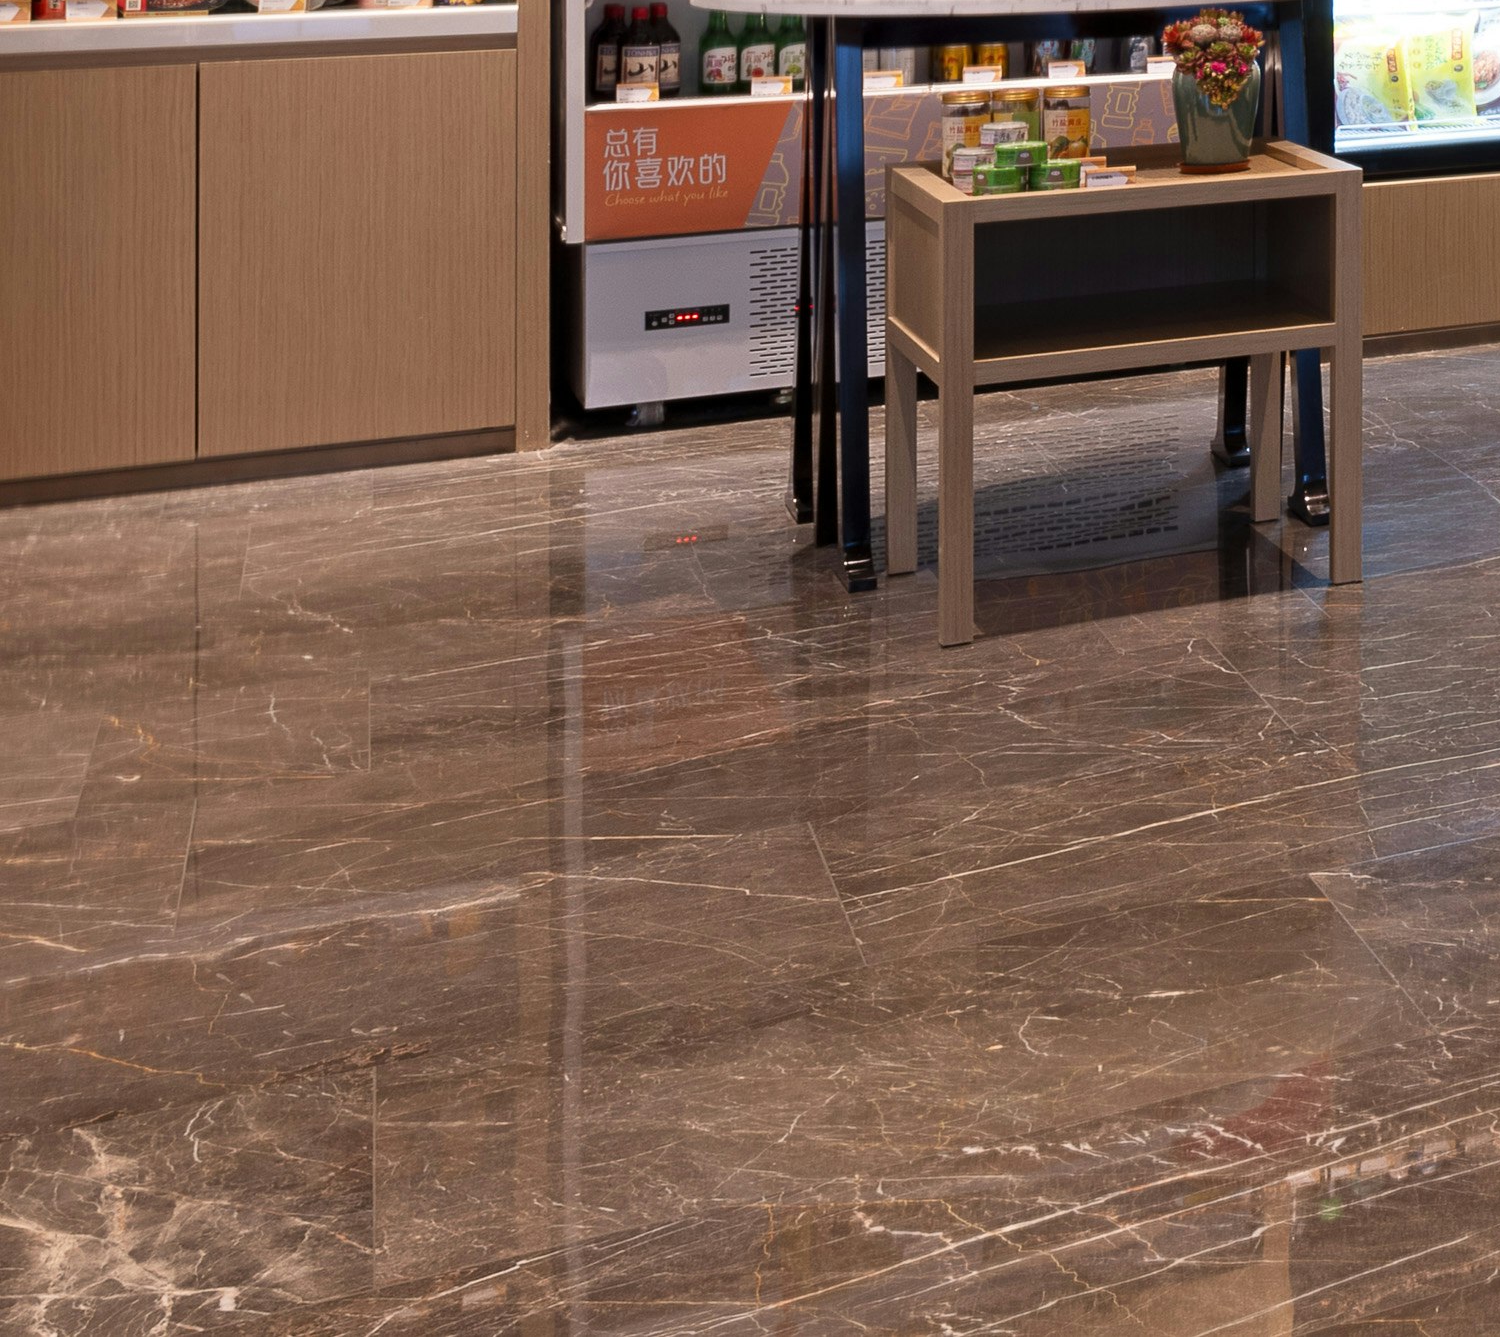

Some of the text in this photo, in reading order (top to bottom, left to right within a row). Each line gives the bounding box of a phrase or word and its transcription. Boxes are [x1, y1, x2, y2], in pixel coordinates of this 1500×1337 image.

[604, 127, 658, 158] 总有
[603, 153, 727, 191] 你喜欢的
[604, 186, 728, 207] Choose what you like
